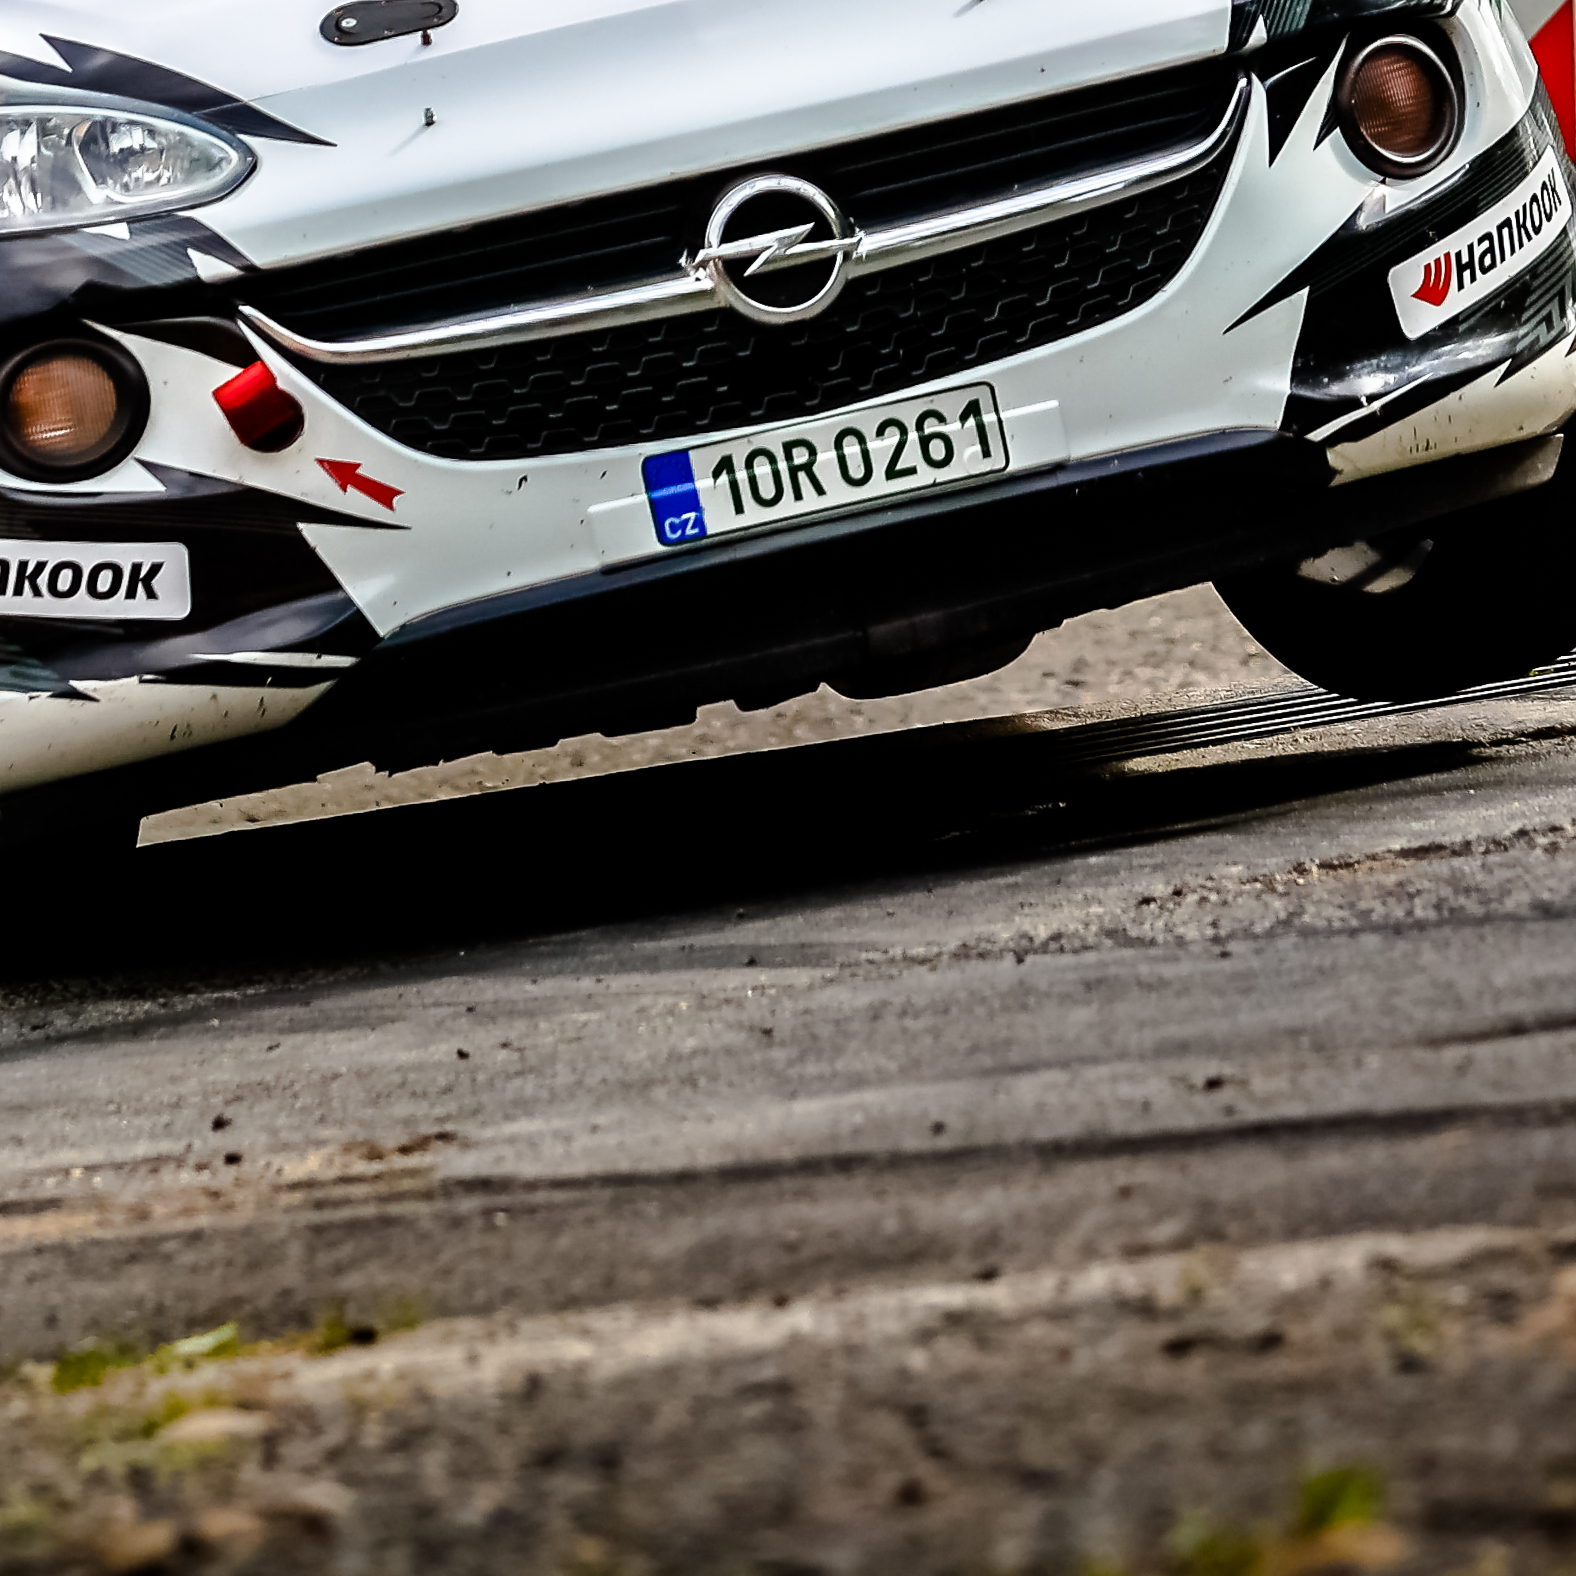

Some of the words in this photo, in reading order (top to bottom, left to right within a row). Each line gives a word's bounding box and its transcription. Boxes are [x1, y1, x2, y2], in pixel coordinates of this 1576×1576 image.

[712, 438, 827, 517] 10R
[832, 398, 993, 488] 0261
[664, 511, 700, 541] CZ
